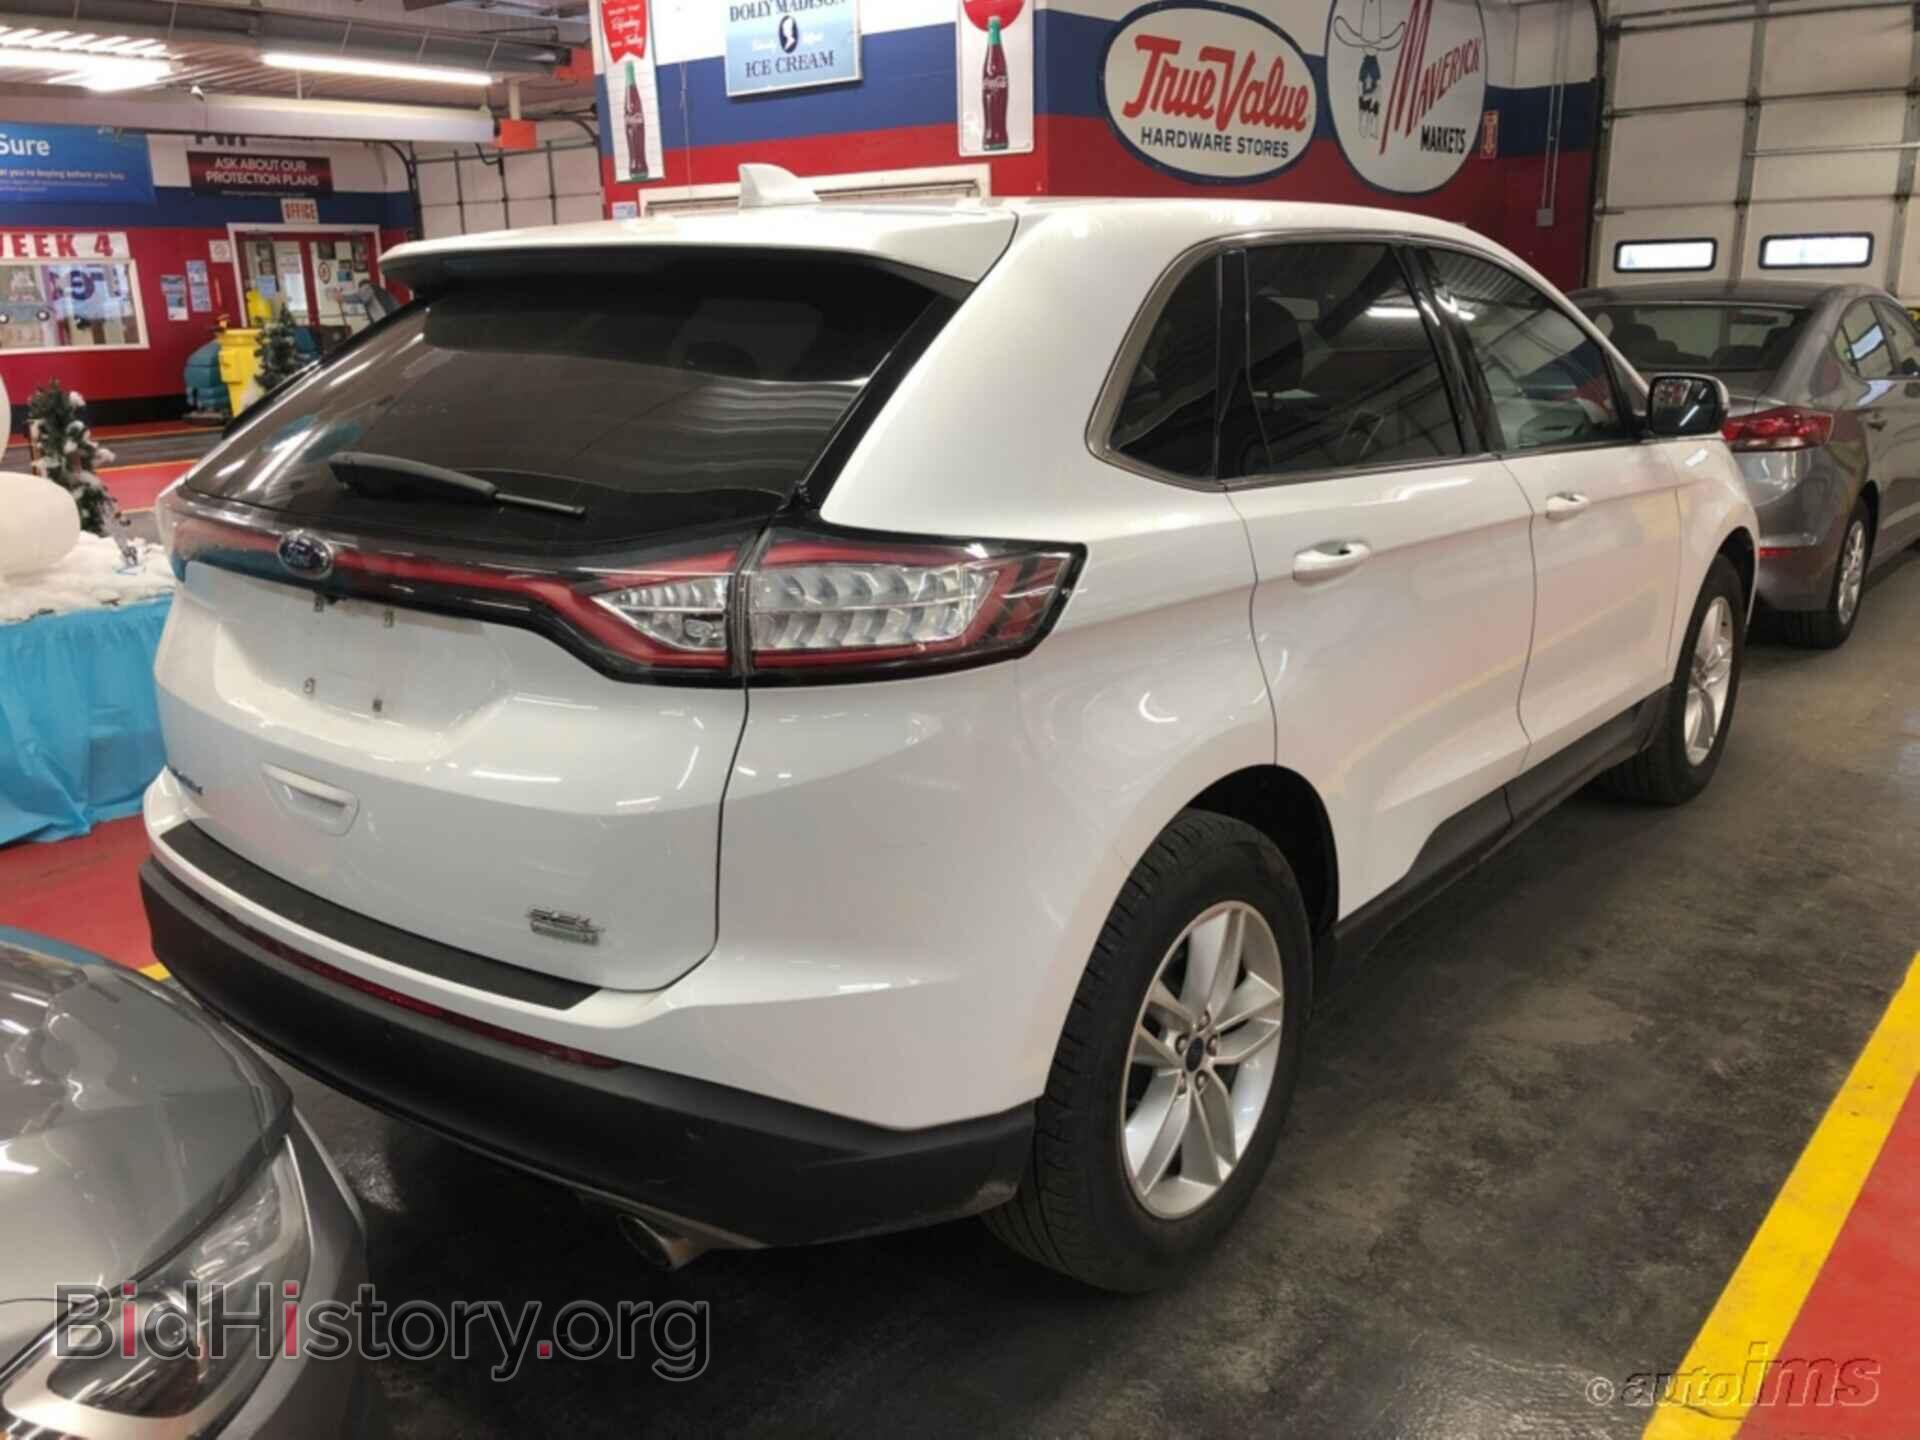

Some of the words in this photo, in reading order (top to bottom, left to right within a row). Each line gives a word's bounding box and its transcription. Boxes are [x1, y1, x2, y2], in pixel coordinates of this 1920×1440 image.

[729, 0, 771, 21] DOLLY
[745, 59, 771, 78] ICE
[775, 50, 834, 73] CREAM
[0, 133, 51, 156] Sure
[1141, 126, 1232, 152] HARDWARE
[1236, 136, 1289, 158] STORES
[1420, 125, 1467, 154] MARKETS
[214, 157, 238, 169] ASK
[240, 159, 279, 171] ABOUT
[280, 160, 307, 172] OUR
[205, 170, 281, 185] PROTECTION
[283, 173, 319, 186] PLANS
[94, 233, 114, 257] 4
